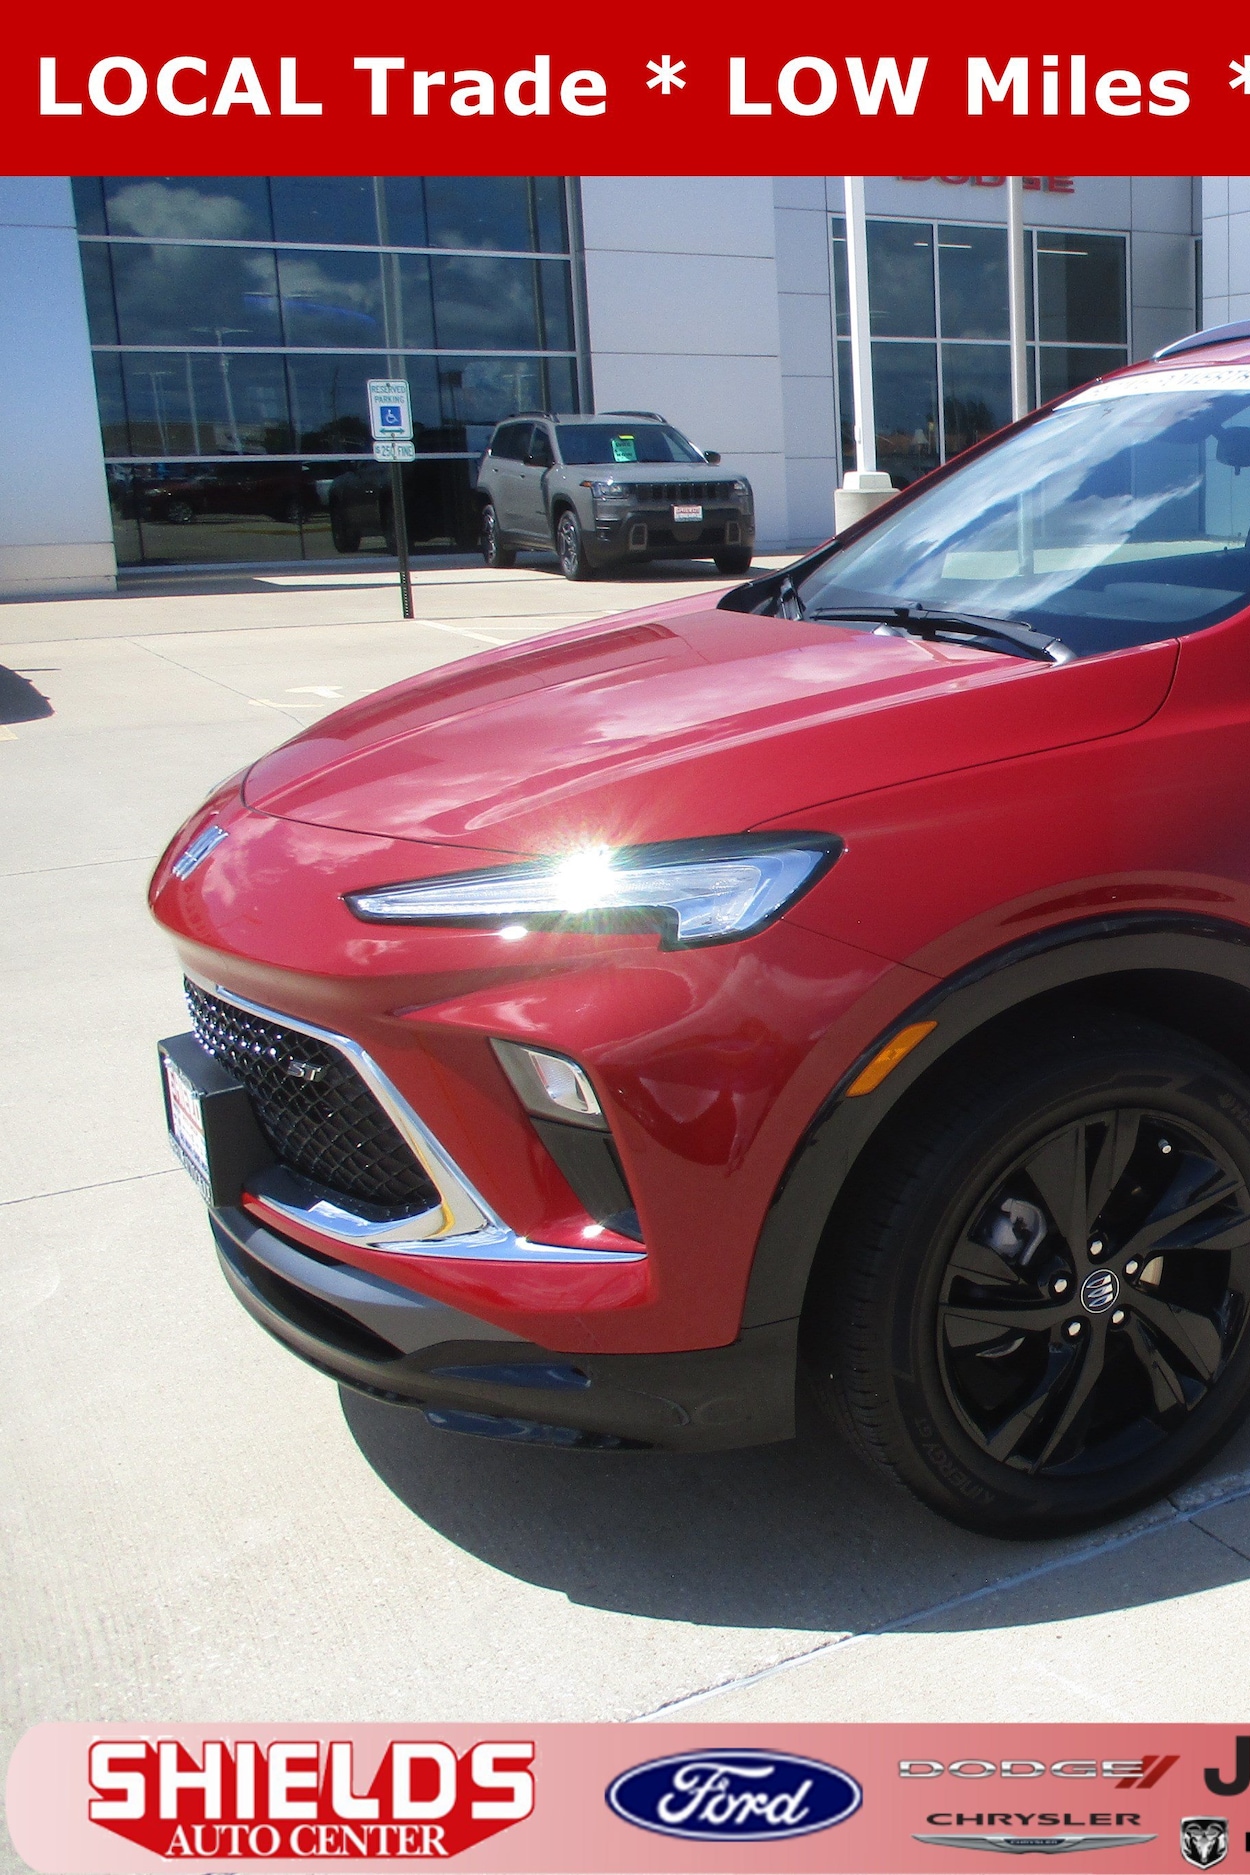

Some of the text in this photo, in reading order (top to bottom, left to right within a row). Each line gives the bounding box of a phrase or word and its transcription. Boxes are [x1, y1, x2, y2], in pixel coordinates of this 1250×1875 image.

[371, 385, 407, 394] RESERVED
[374, 395, 405, 404] PARKING
[398, 445, 414, 457] FINE
[287, 1060, 324, 1082] ST
